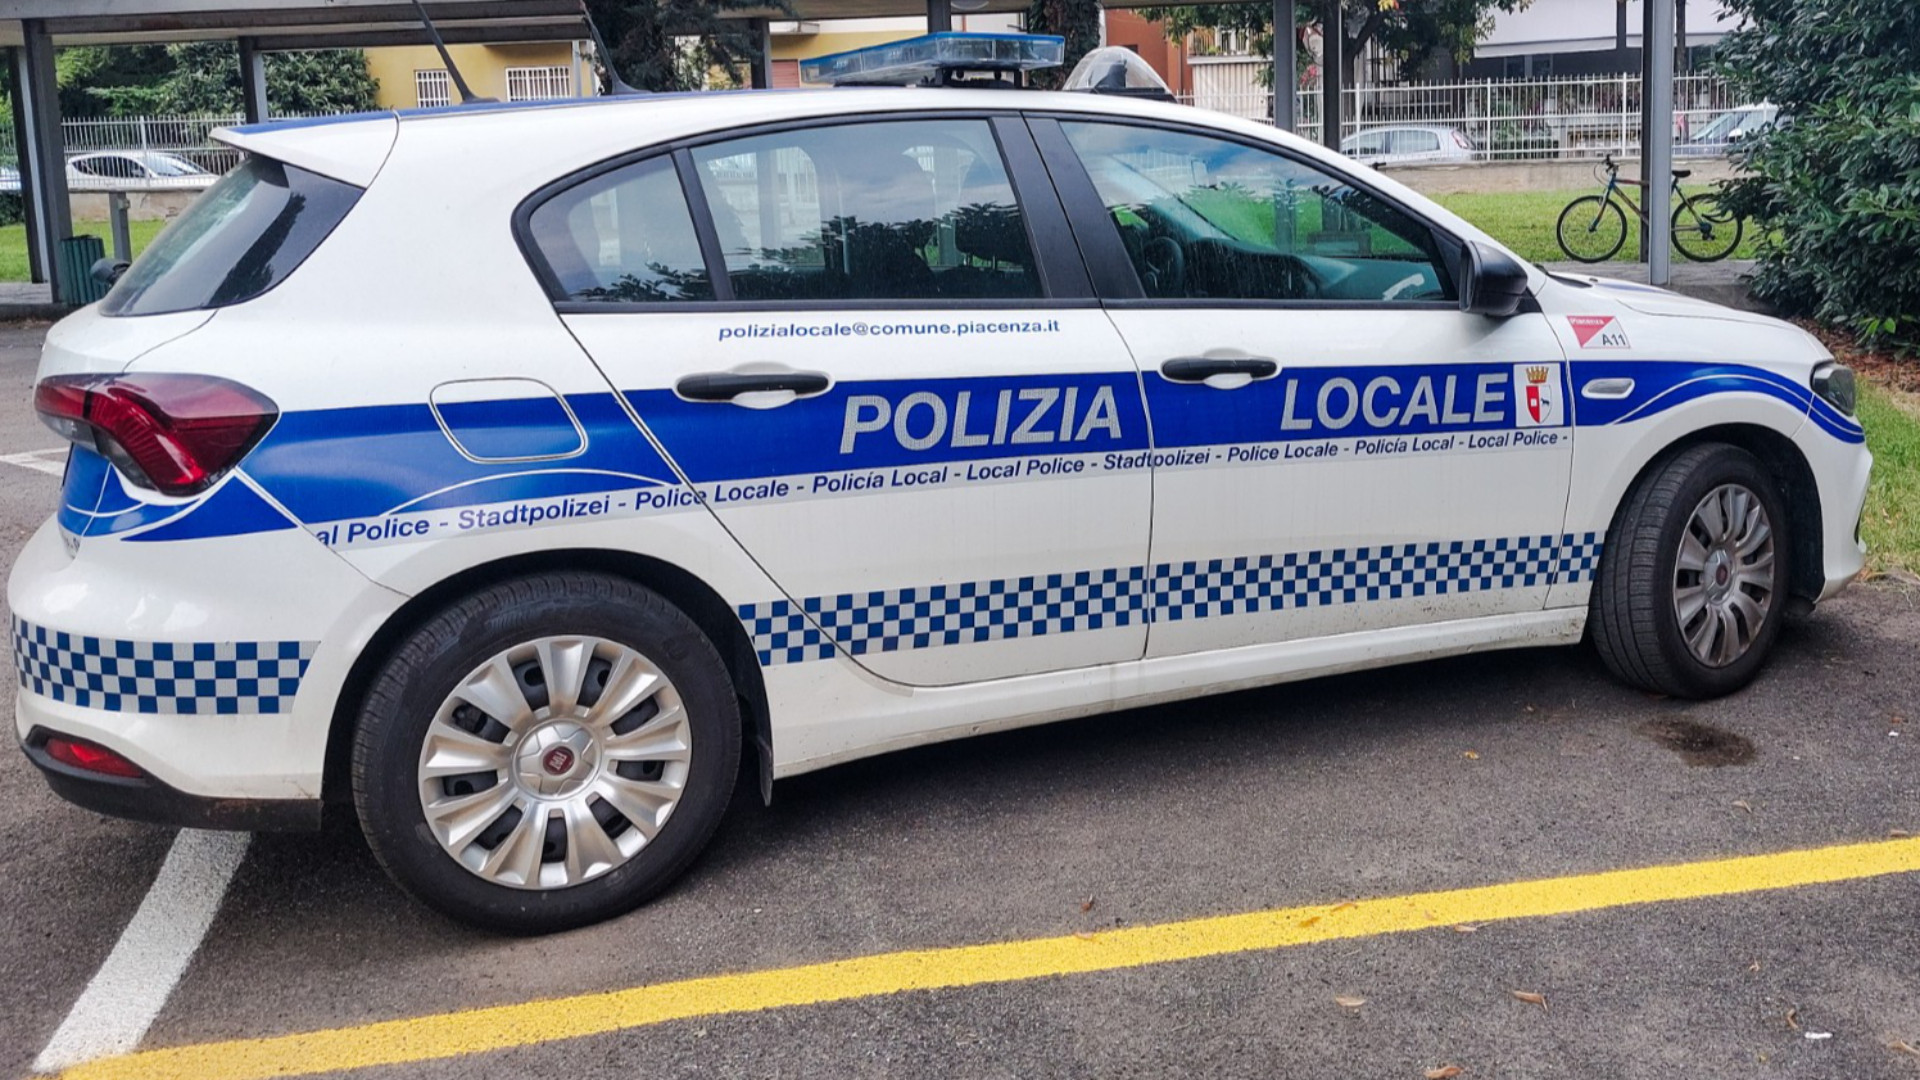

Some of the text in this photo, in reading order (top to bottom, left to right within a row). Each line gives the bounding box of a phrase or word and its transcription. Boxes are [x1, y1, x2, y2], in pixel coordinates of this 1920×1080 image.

[718, 320, 1060, 342] polizialocale@comune.piacenza.it
[1602, 333, 1626, 346] A11
[839, 373, 1508, 454] POLIZIA LOCALE
[347, 518, 430, 543] Police
[458, 495, 610, 529] Stadtpolizei
[635, 488, 706, 511] Police
[714, 480, 789, 502] Locale
[812, 471, 884, 494] Policía
[891, 466, 947, 487] Local
[966, 461, 1021, 481] Local
[1026, 457, 1084, 476] Police
[1104, 448, 1211, 470] Stadtpolizei
[1227, 444, 1279, 462] Police
[1284, 441, 1338, 459] Locale
[1354, 437, 1407, 455] Policía
[1412, 436, 1455, 452] Local
[1468, 432, 1509, 449] Local
[1512, 430, 1558, 447] Police
